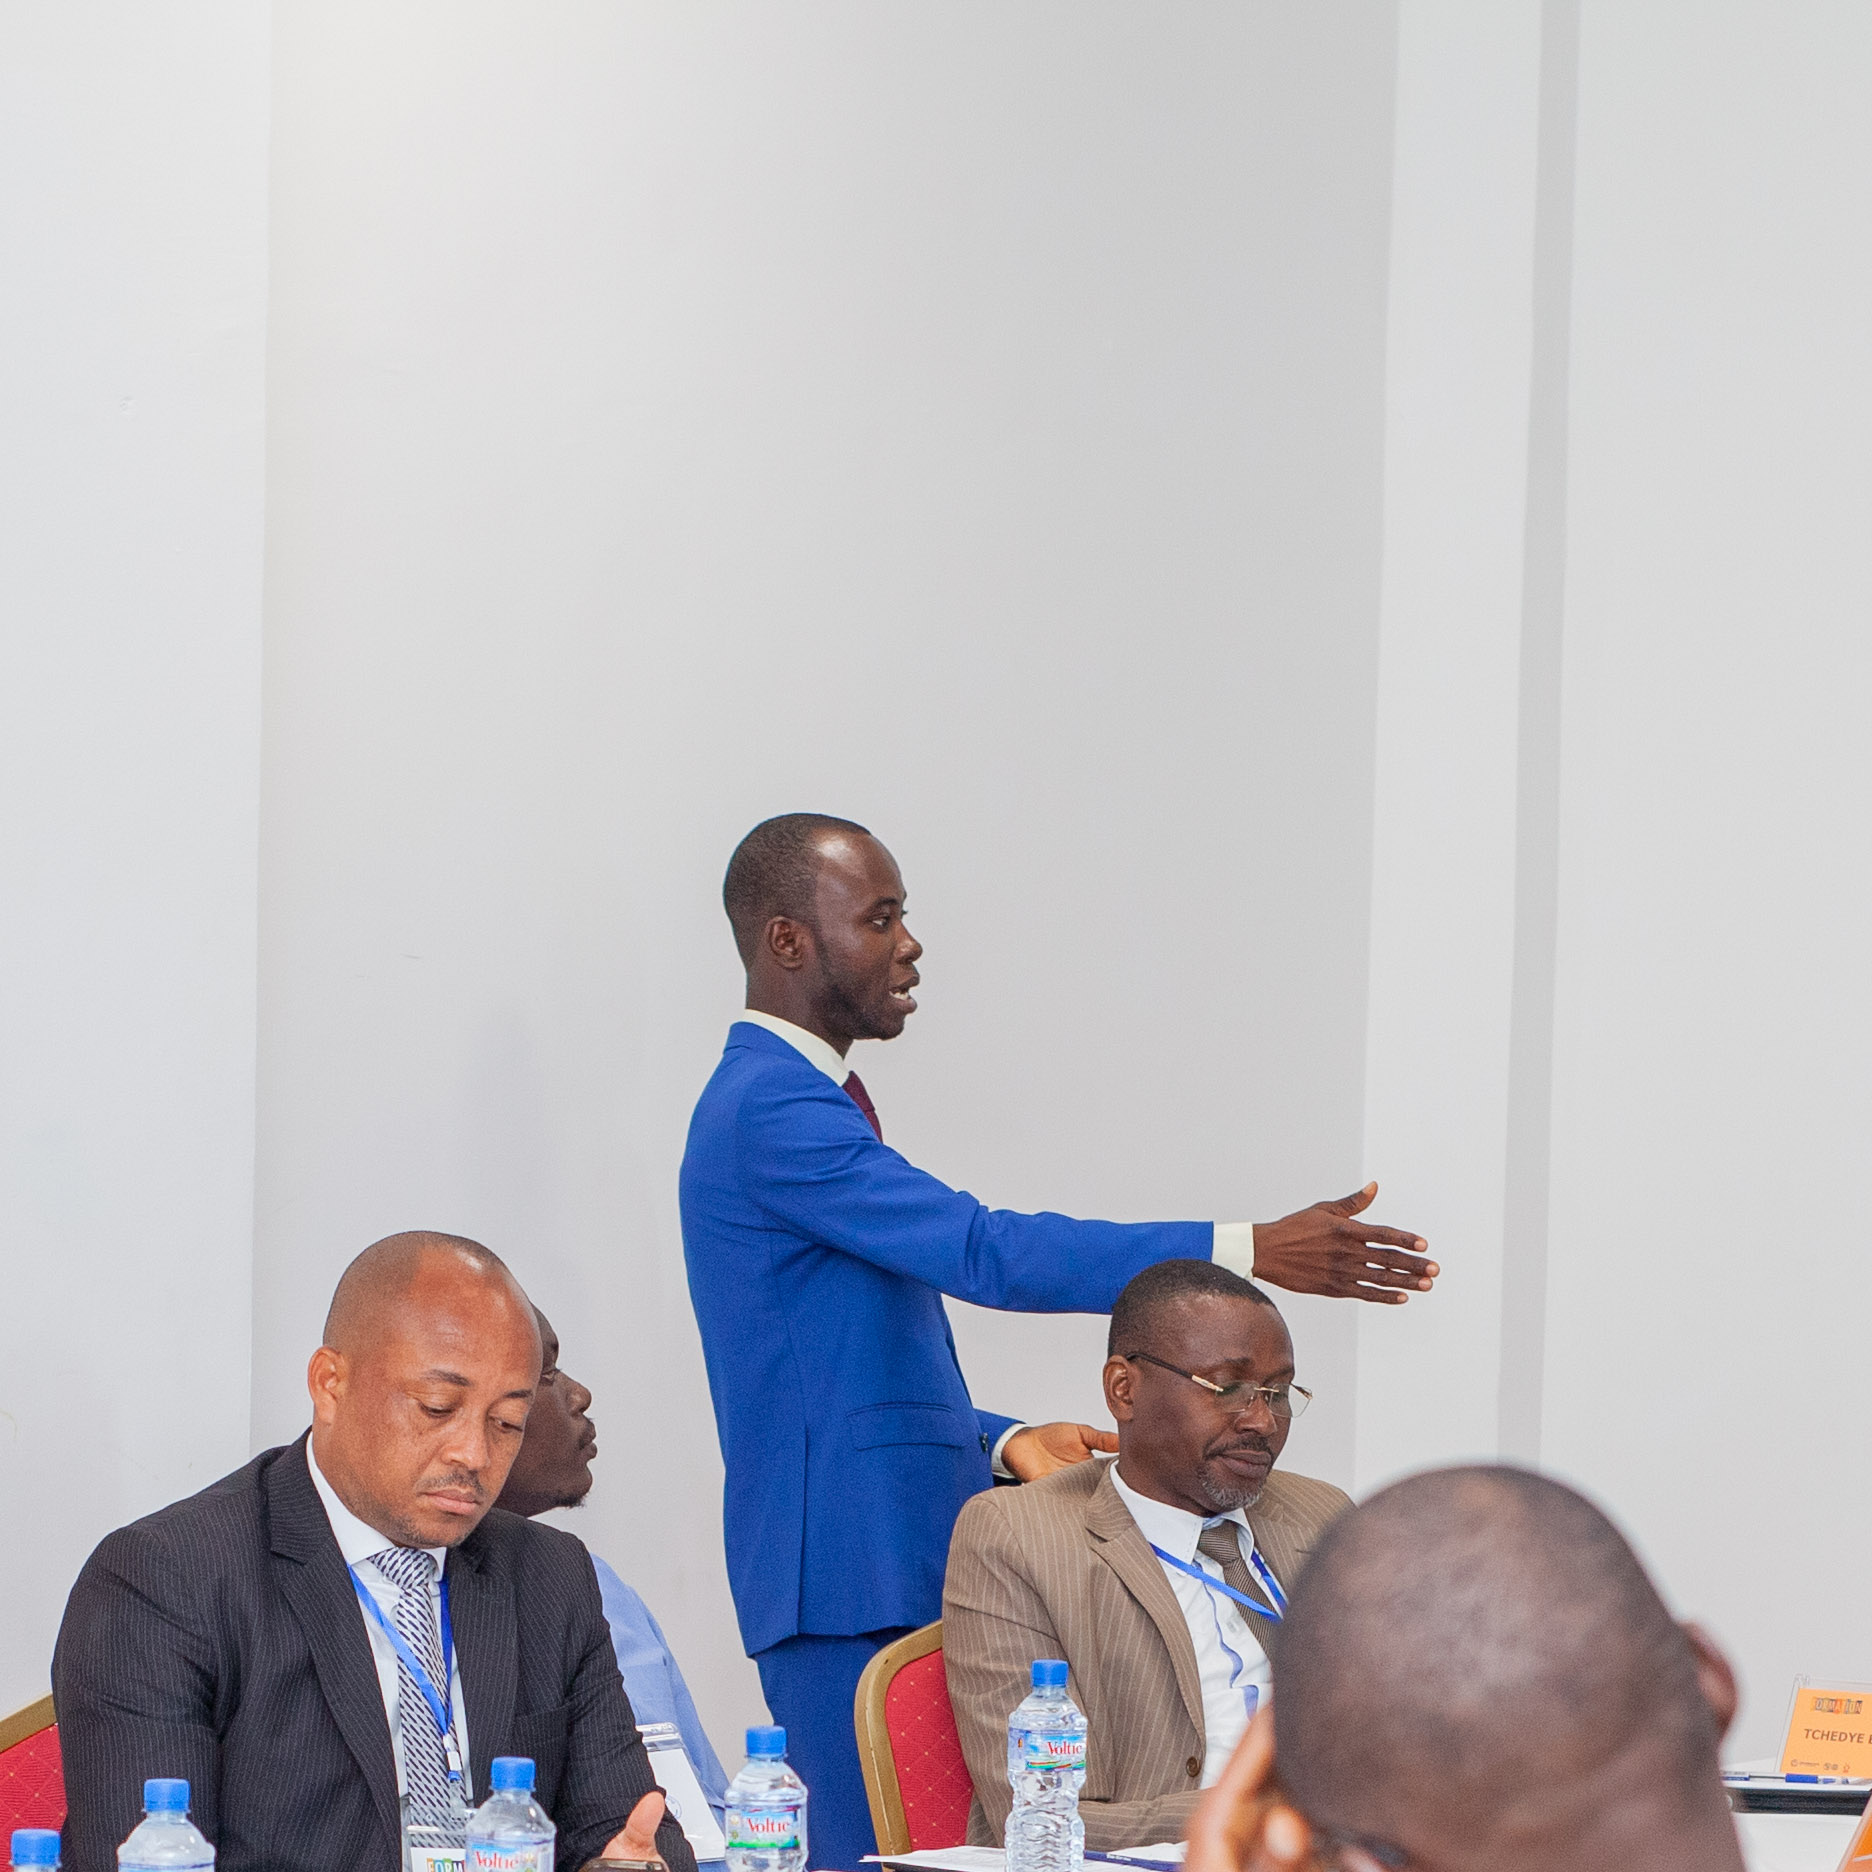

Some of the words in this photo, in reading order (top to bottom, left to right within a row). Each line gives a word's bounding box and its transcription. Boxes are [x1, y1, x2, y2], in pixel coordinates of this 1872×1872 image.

[1804, 1728, 1865, 1744] TCHEDYE
[747, 1817, 790, 1833] Voltic
[475, 1850, 520, 1869] Voltic
